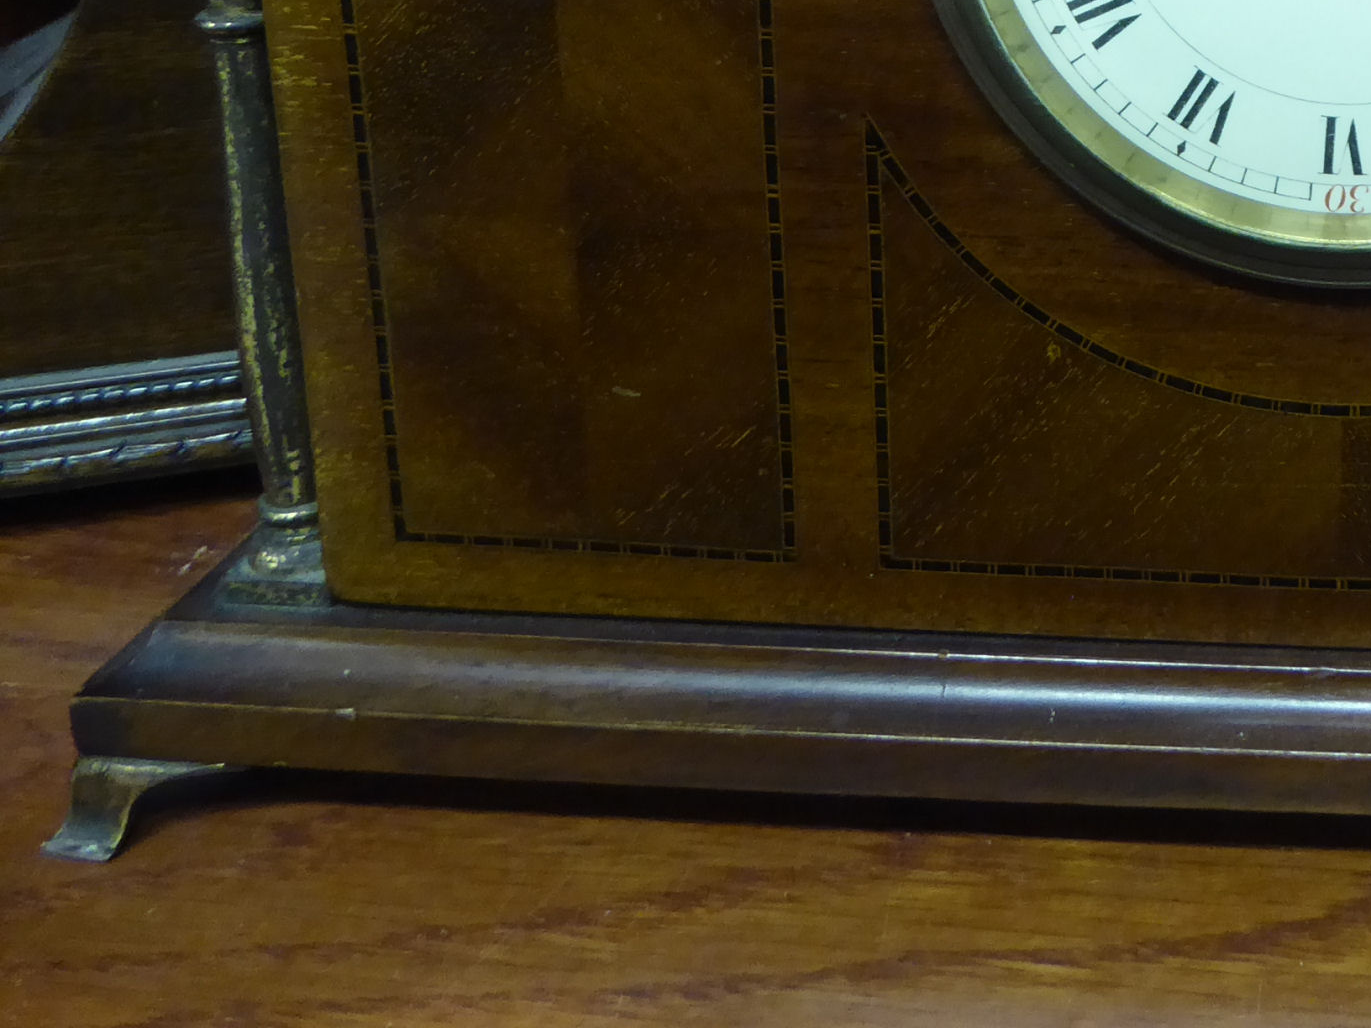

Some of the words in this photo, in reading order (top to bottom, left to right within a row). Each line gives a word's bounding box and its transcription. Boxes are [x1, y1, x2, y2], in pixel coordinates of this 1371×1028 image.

[1166, 64, 1237, 148] VII
[1320, 114, 1369, 176] VI
[1324, 183, 1371, 214] 30
